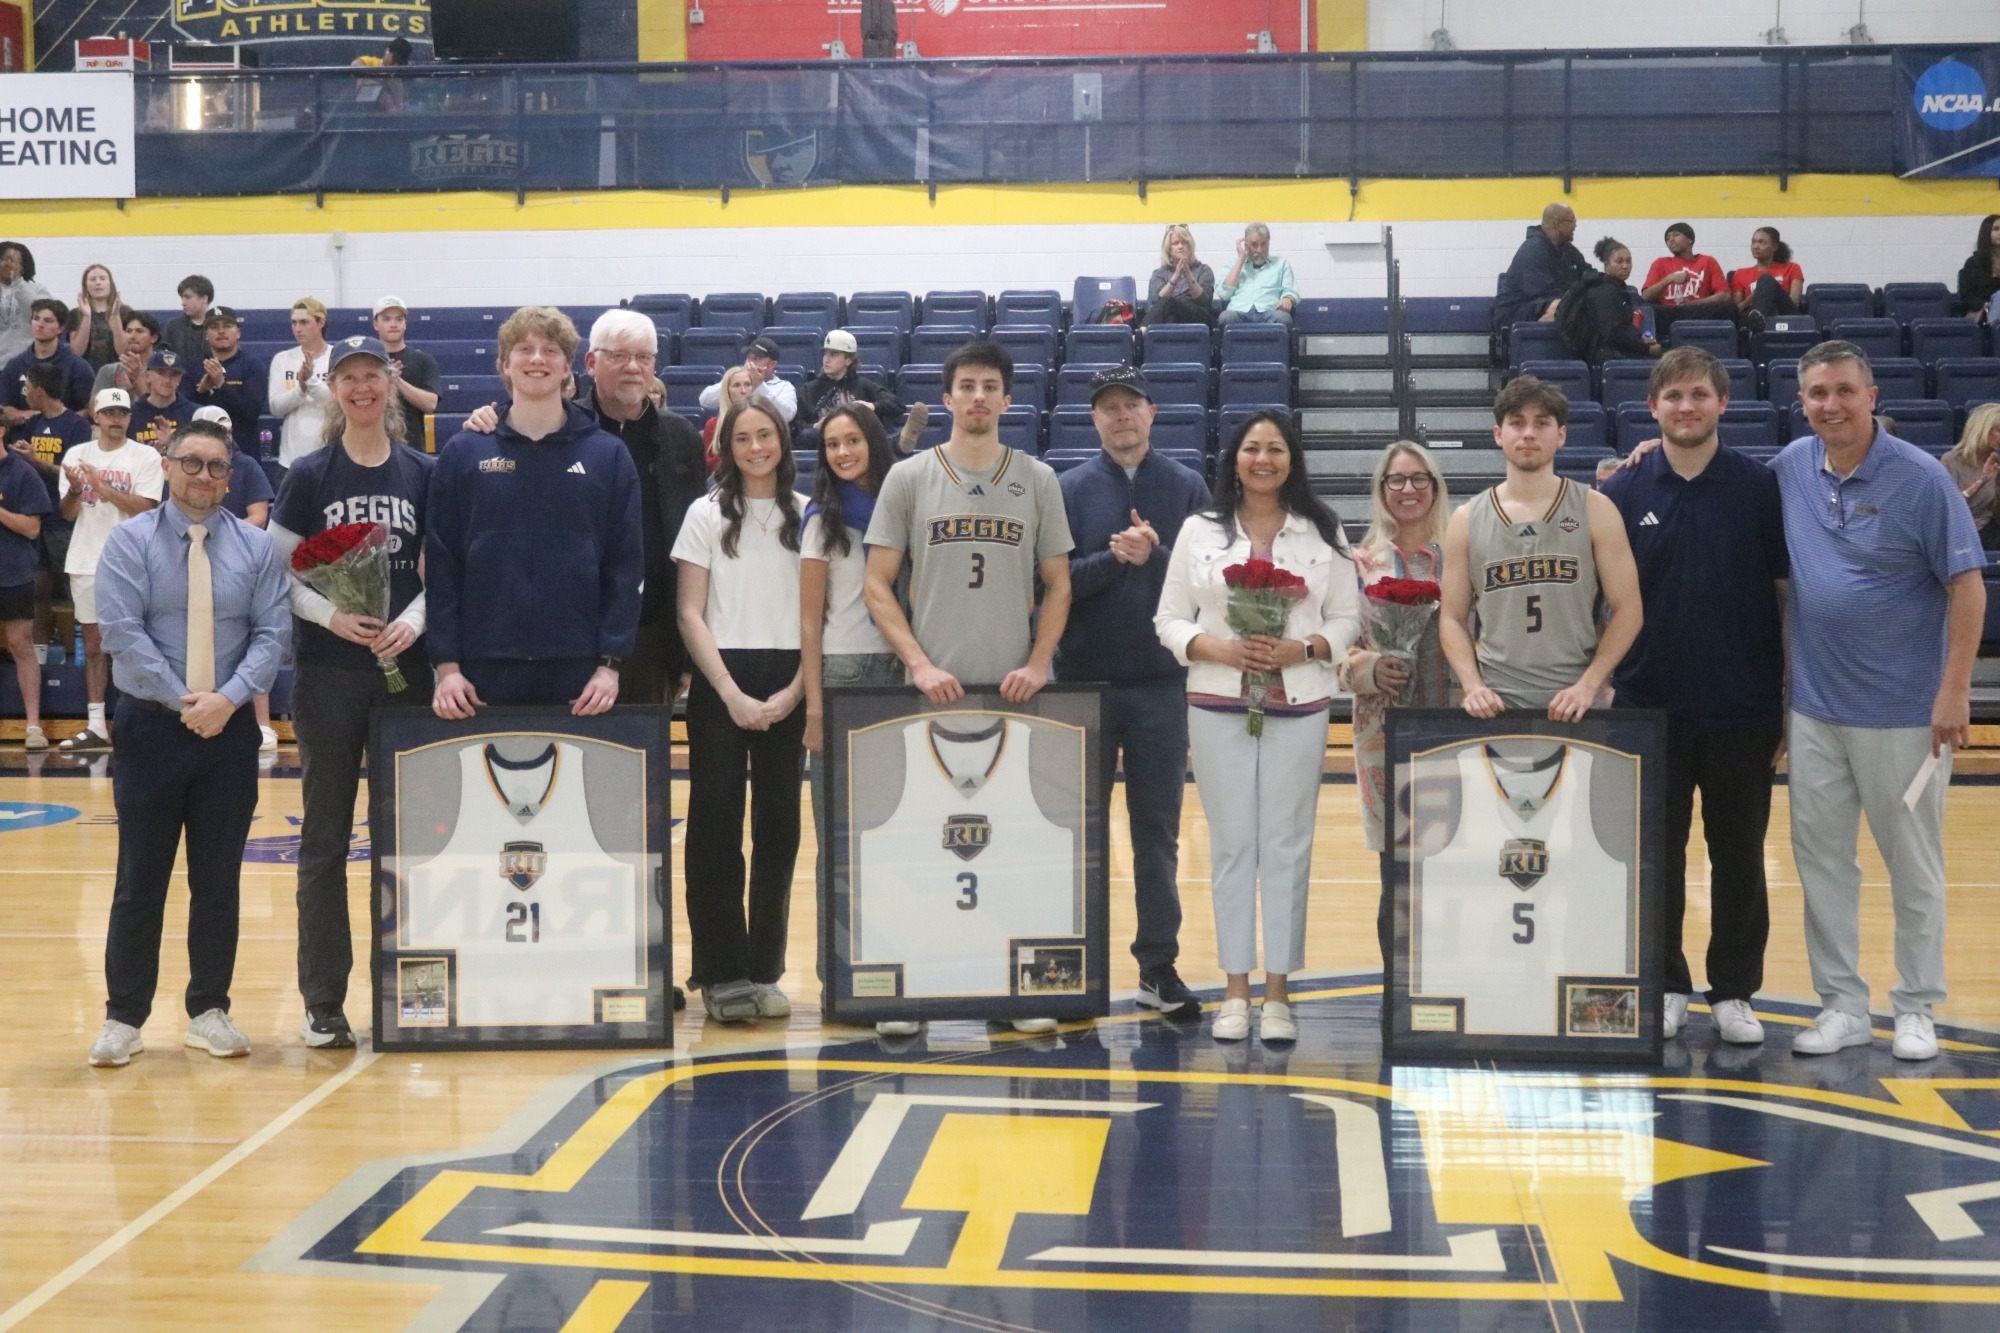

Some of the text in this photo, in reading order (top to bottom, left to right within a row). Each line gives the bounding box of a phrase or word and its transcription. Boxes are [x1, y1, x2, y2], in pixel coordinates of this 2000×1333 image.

[220, 13, 426, 38] ATHLETICS
[0, 107, 96, 133] HOME
[323, 495, 416, 536] REGIS
[930, 517, 1024, 544] REGIS
[968, 553, 985, 589] 3
[1485, 557, 1579, 590] REGIS
[1526, 595, 1543, 634] 5
[945, 825, 991, 847] RU
[1501, 851, 1549, 874] RU
[956, 871, 978, 911] 3
[505, 902, 539, 943] 21
[1512, 902, 1535, 945] 5
